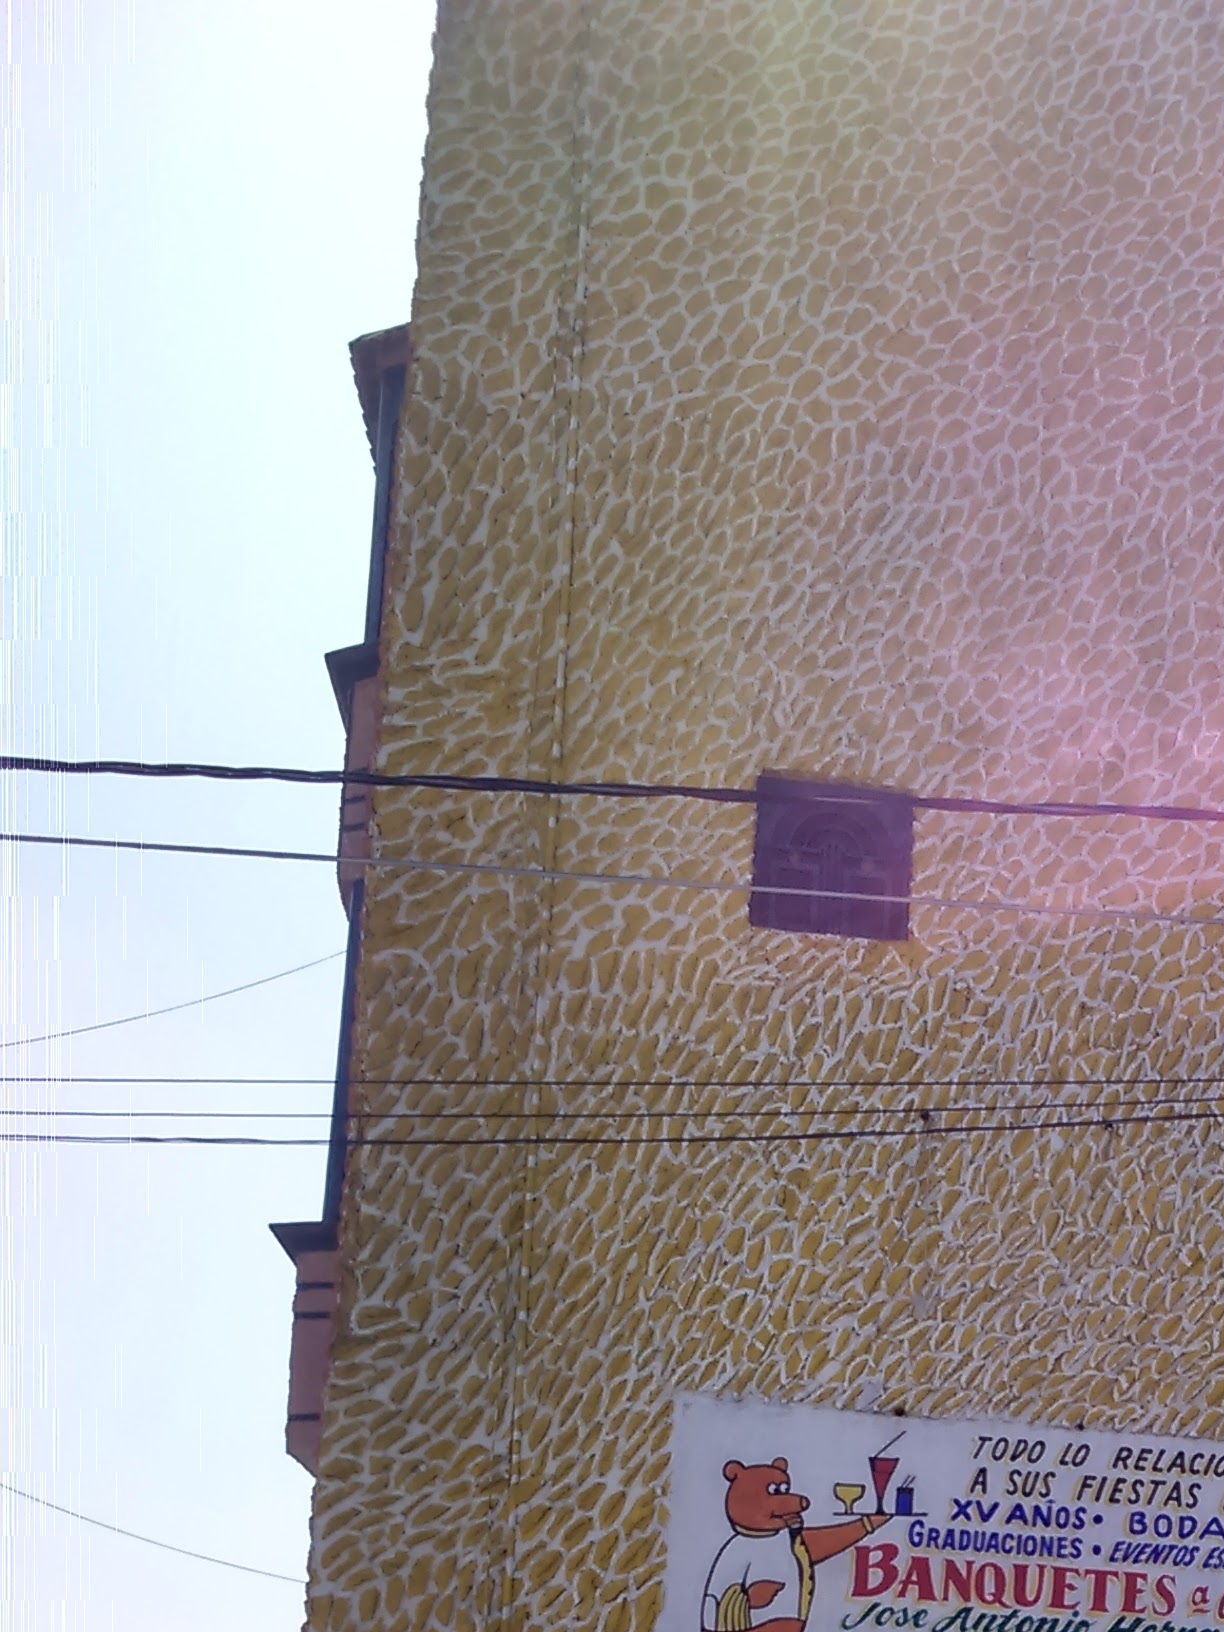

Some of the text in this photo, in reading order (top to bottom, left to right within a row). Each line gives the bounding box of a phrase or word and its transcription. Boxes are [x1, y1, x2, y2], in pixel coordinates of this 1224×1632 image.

[972, 1437, 1046, 1463] TODO
[1058, 1443, 1091, 1468] LO
[970, 1467, 988, 1495] A
[1006, 1469, 1056, 1499] SUS
[1076, 1475, 1202, 1509] FIESTAS
[950, 1498, 1000, 1523] XV
[1005, 1500, 1088, 1530] AÑOS
[908, 1519, 1083, 1560] GRADUACIONES
[1108, 1540, 1198, 1568] EVENTOS
[851, 1543, 1177, 1617] BANQUETES
[842, 1602, 928, 1631] Jose
